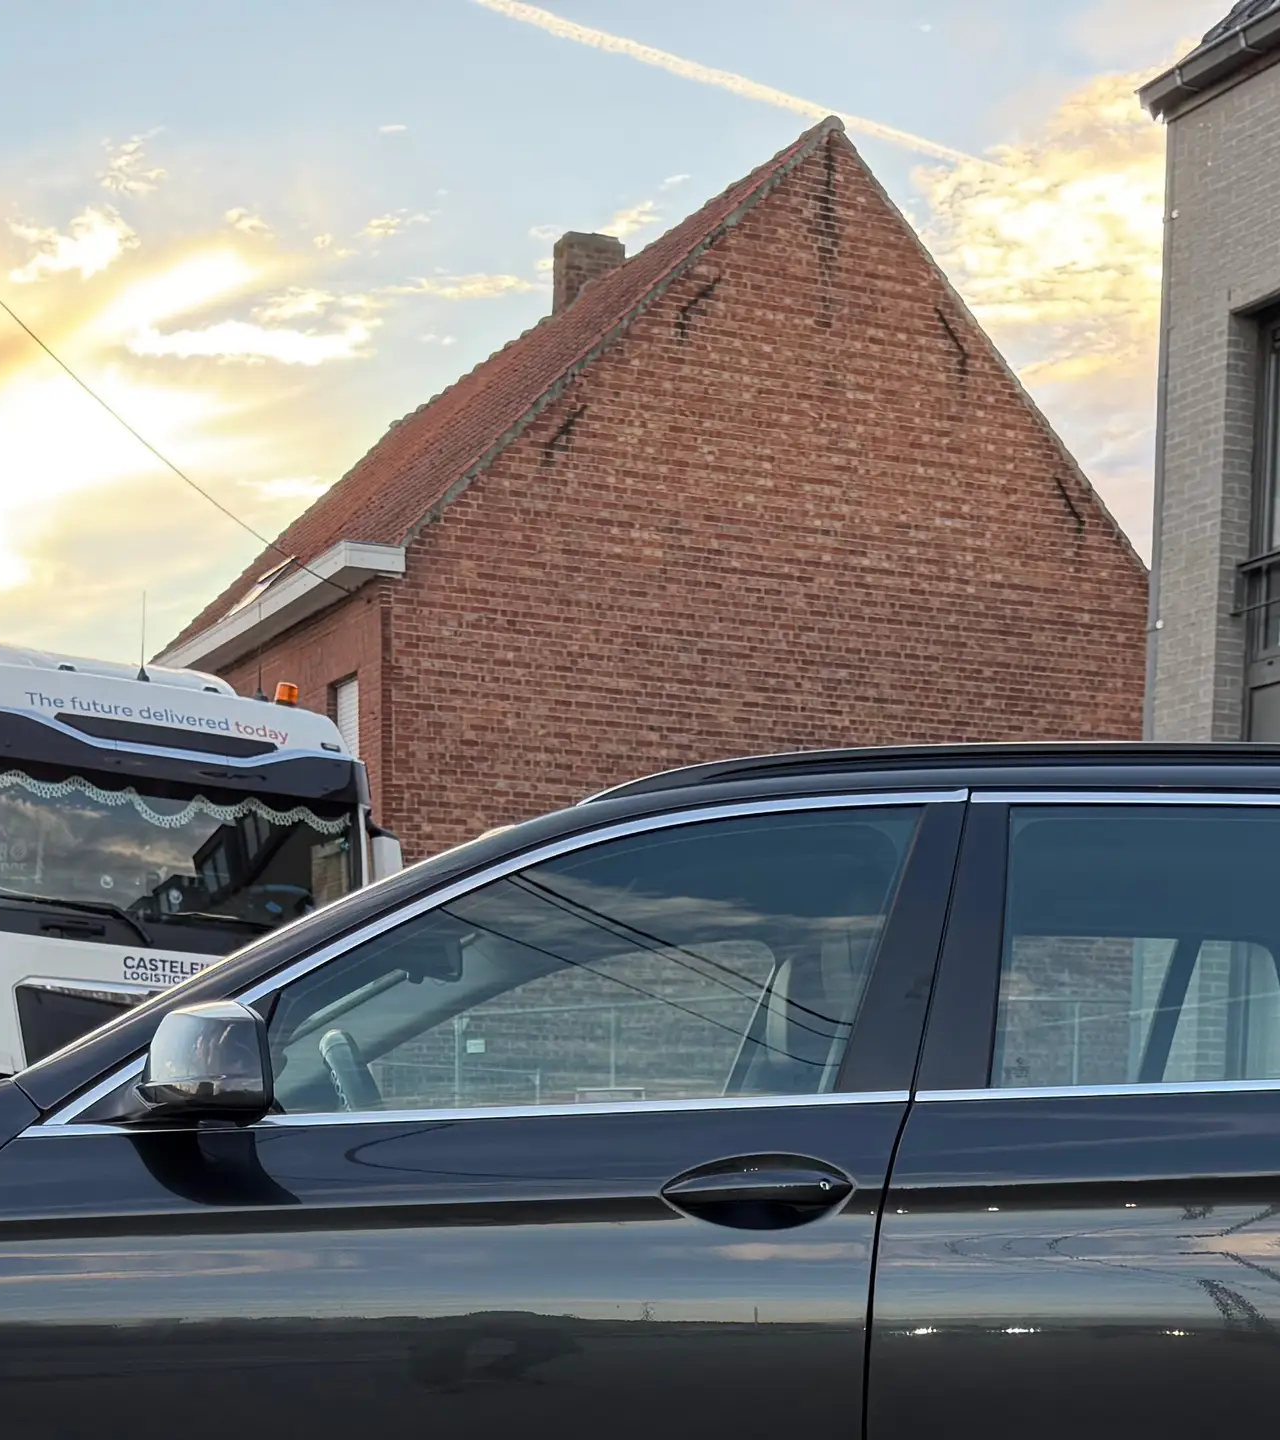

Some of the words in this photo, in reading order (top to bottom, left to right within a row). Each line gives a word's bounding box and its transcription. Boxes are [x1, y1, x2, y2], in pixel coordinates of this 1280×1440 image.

[25, 691, 65, 709] The
[70, 696, 133, 718] future
[139, 706, 231, 732] delivered
[234, 720, 290, 745] today
[123, 956, 212, 976] CASTELEI
